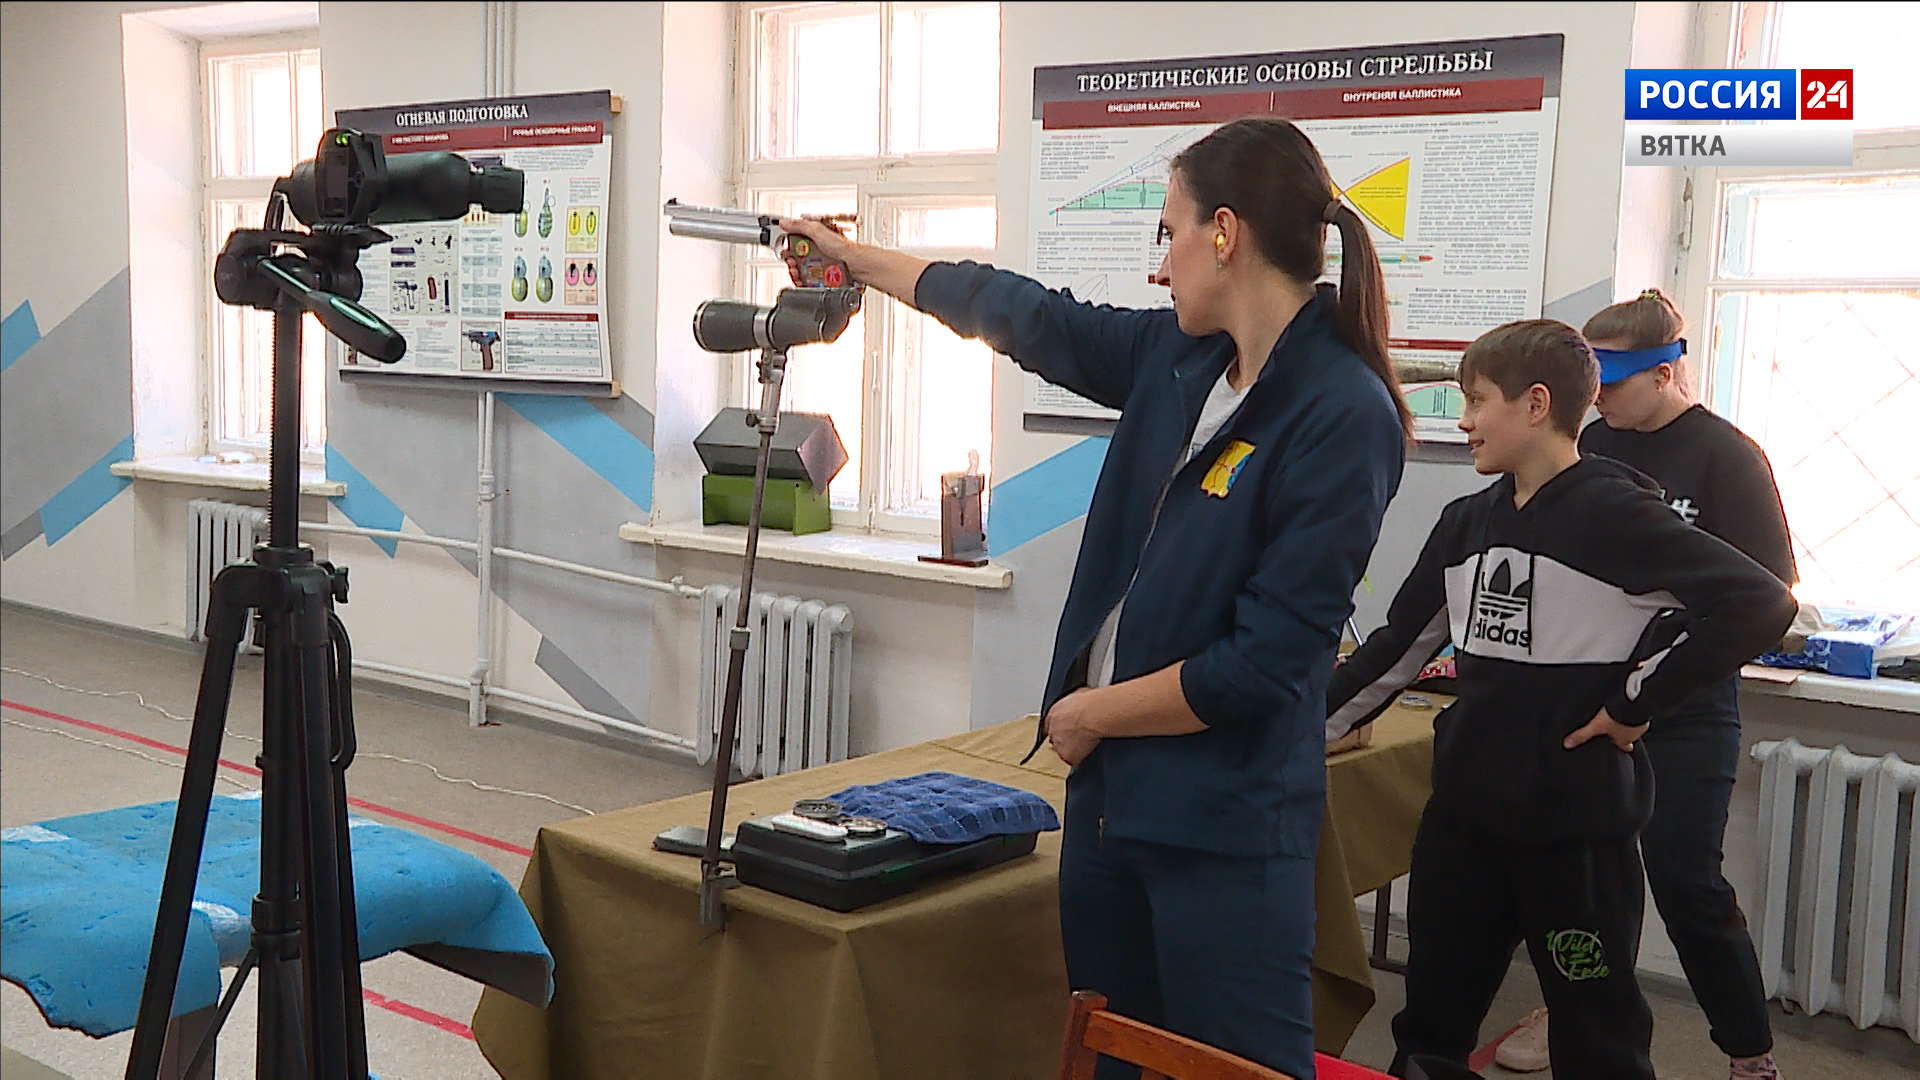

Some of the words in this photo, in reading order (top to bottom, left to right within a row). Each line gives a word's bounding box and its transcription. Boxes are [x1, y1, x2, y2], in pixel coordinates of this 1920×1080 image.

[1077, 65, 1249, 92] ТЕОРЕТИЧЕСКИЕ
[1255, 58, 1352, 83] ОСНОВЫ
[1359, 50, 1494, 77] СТРЕЛЬБЫ
[1399, 87, 1463, 100] БАЛЛИСТИКА
[396, 110, 446, 126] ОГНЕВАЯ
[449, 103, 529, 124] ПОДГОТОВКА
[1107, 102, 1147, 113] ВНЕШНЯЯ
[1148, 100, 1202, 111] БАЛЛИСТИКА
[1474, 617, 1531, 648] didas
